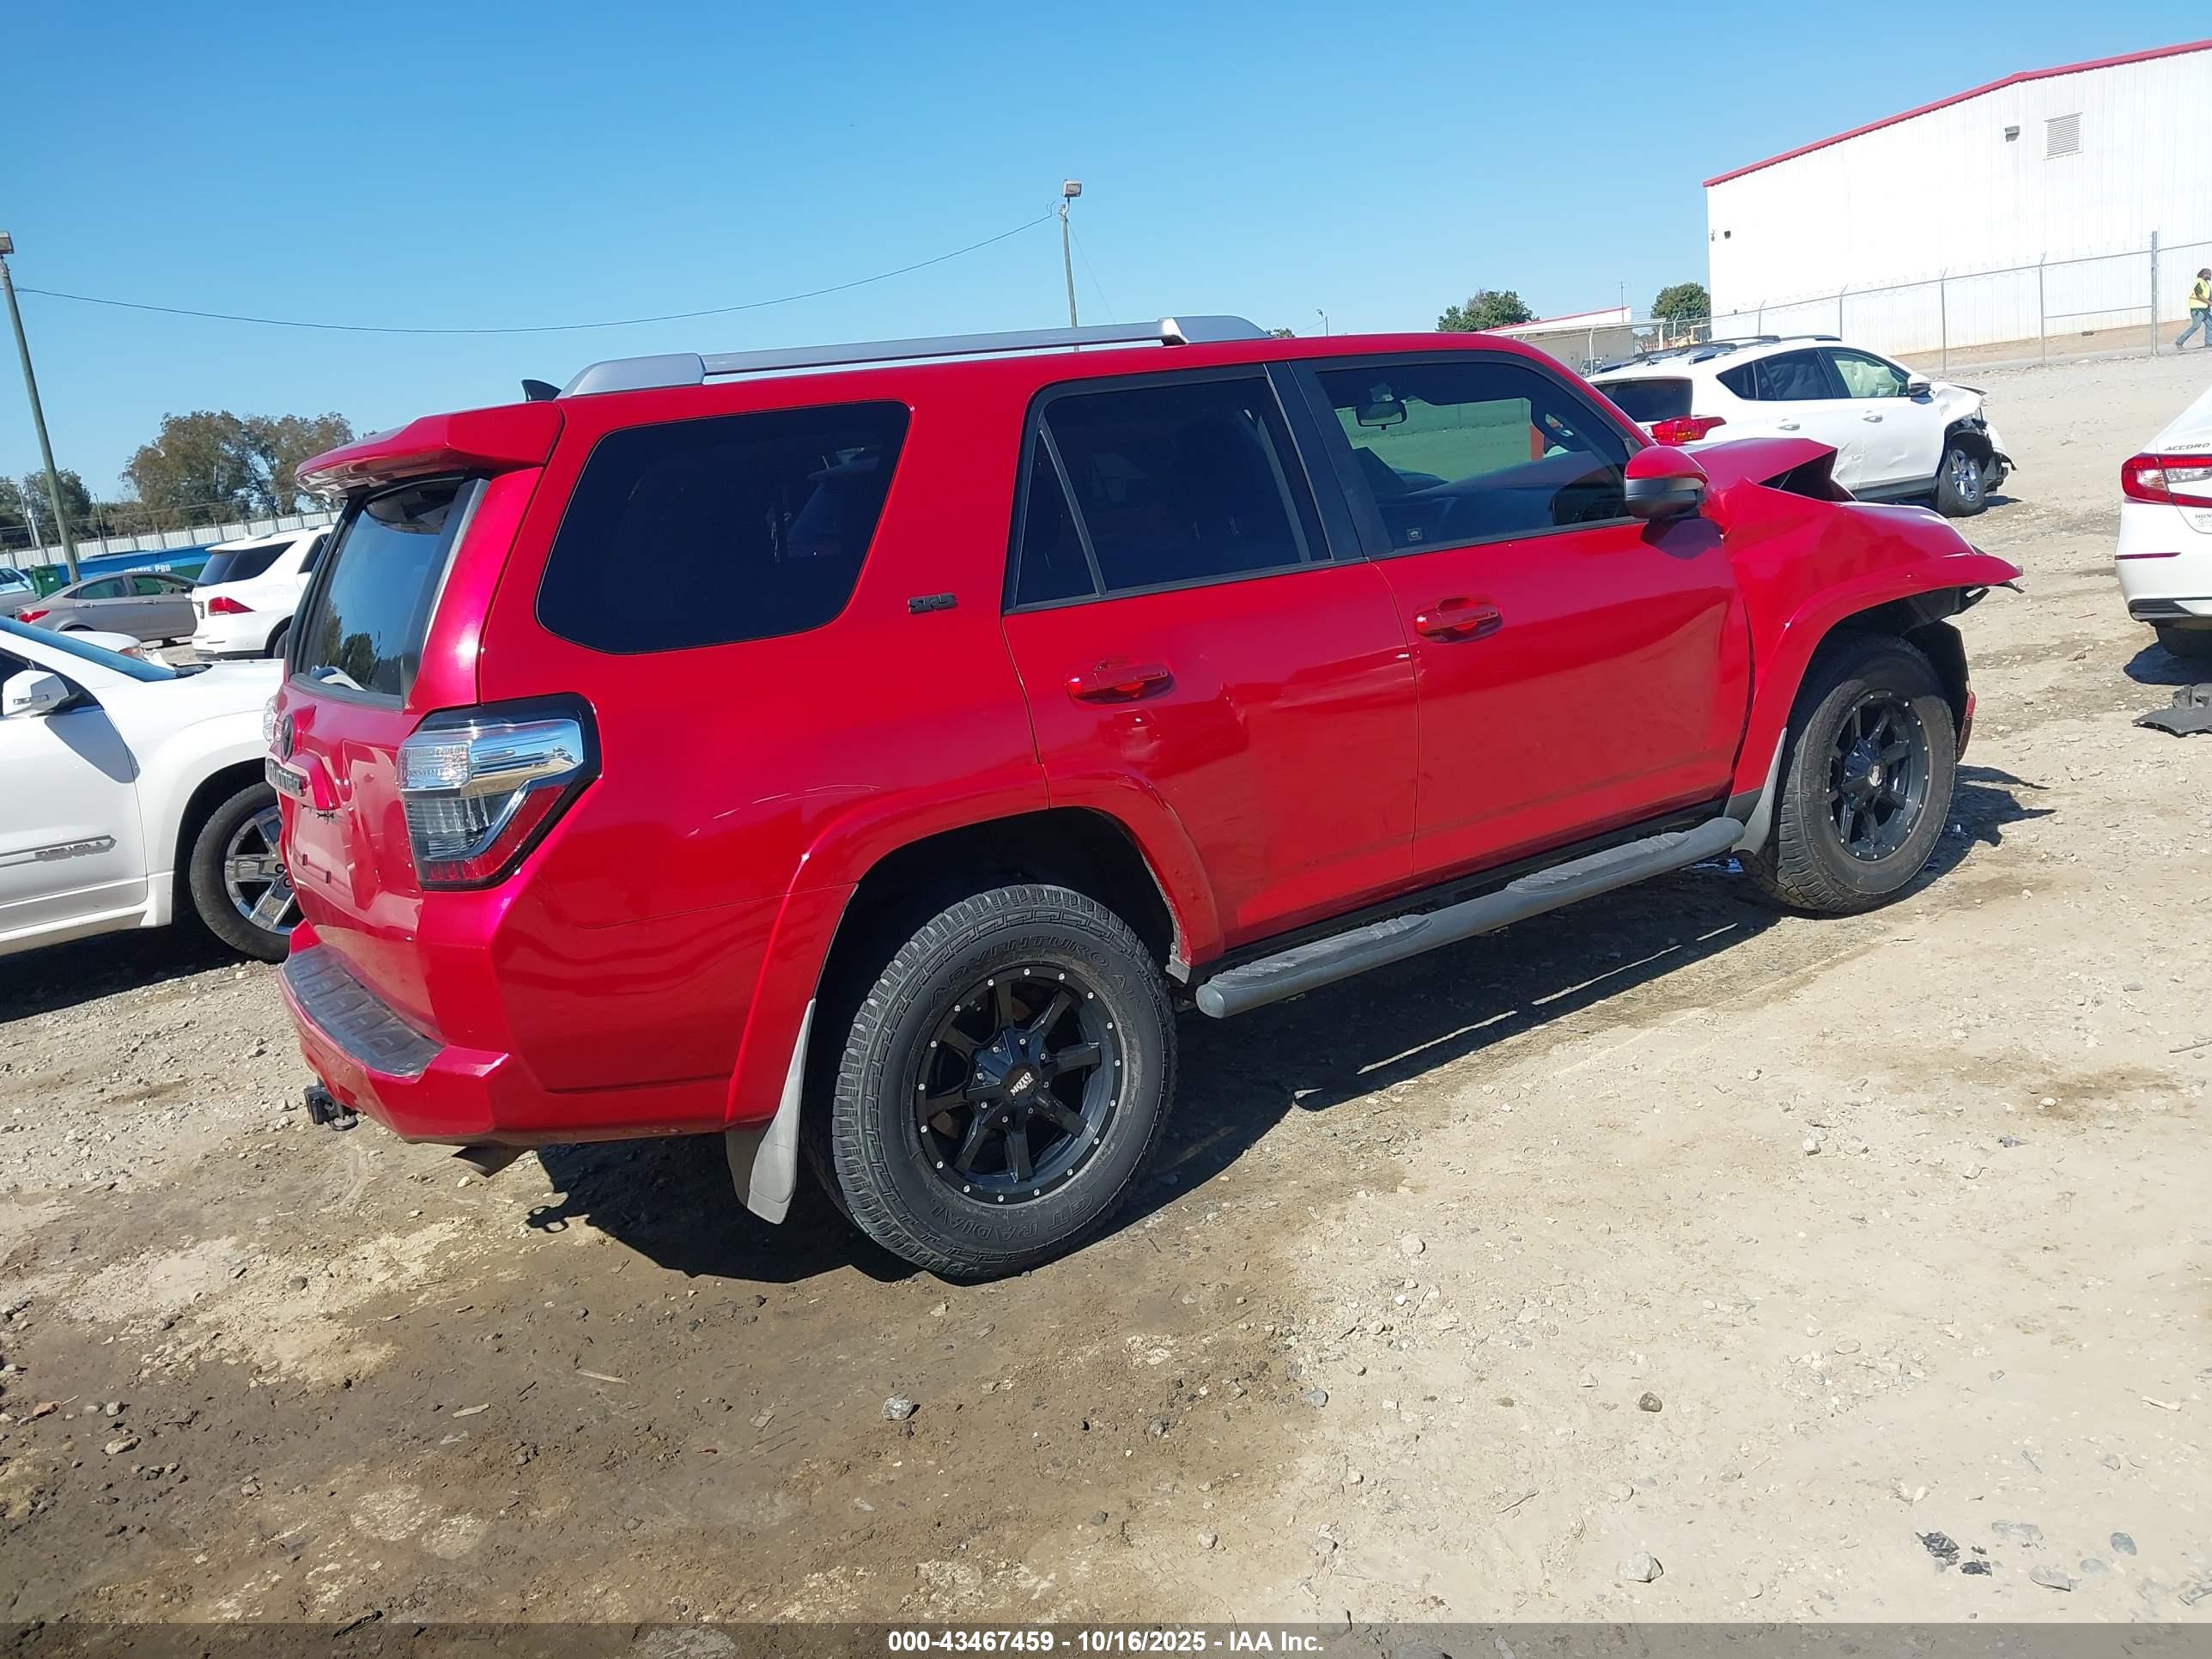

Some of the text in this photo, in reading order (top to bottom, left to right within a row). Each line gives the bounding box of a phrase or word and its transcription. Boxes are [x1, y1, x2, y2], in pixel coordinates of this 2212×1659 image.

[2163, 442, 2210, 452] ACCORD
[908, 593, 957, 614] SR5
[928, 1194, 1094, 1243] GT RADIAL
